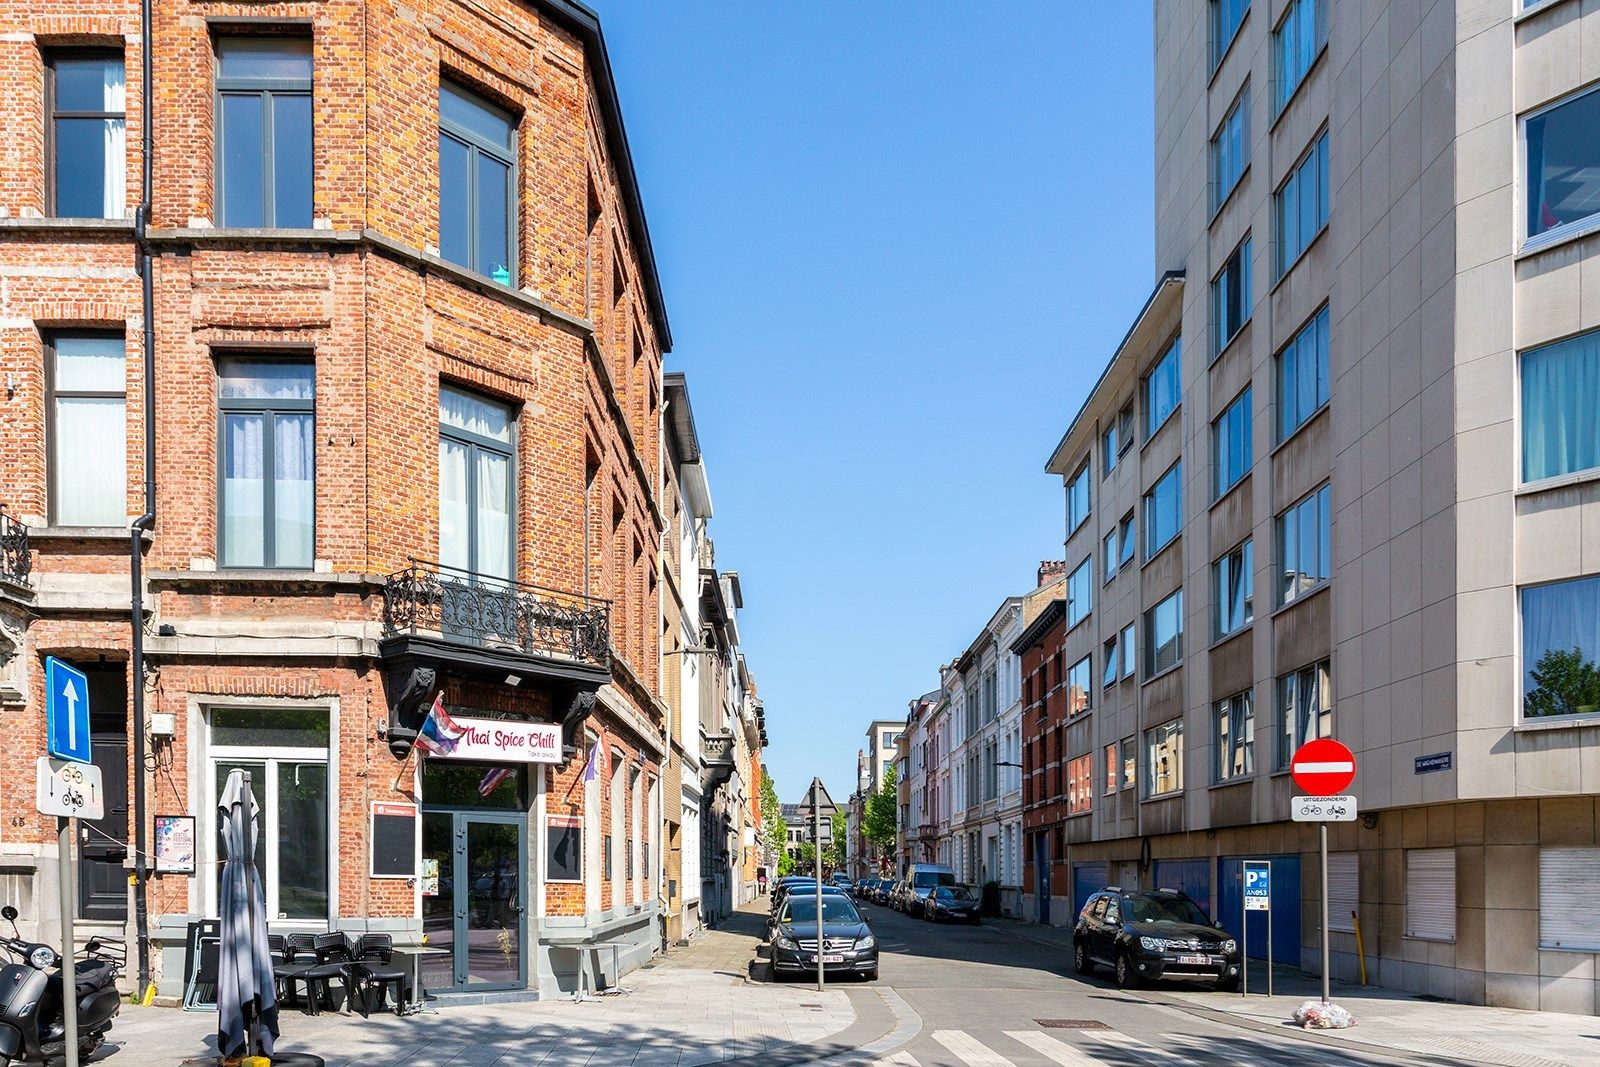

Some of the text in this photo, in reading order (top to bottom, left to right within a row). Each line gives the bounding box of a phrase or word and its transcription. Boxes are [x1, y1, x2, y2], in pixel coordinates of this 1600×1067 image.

[466, 727, 555, 751] Thai Spice Chili
[528, 750, 541, 758] Take
[1246, 871, 1258, 888] P
